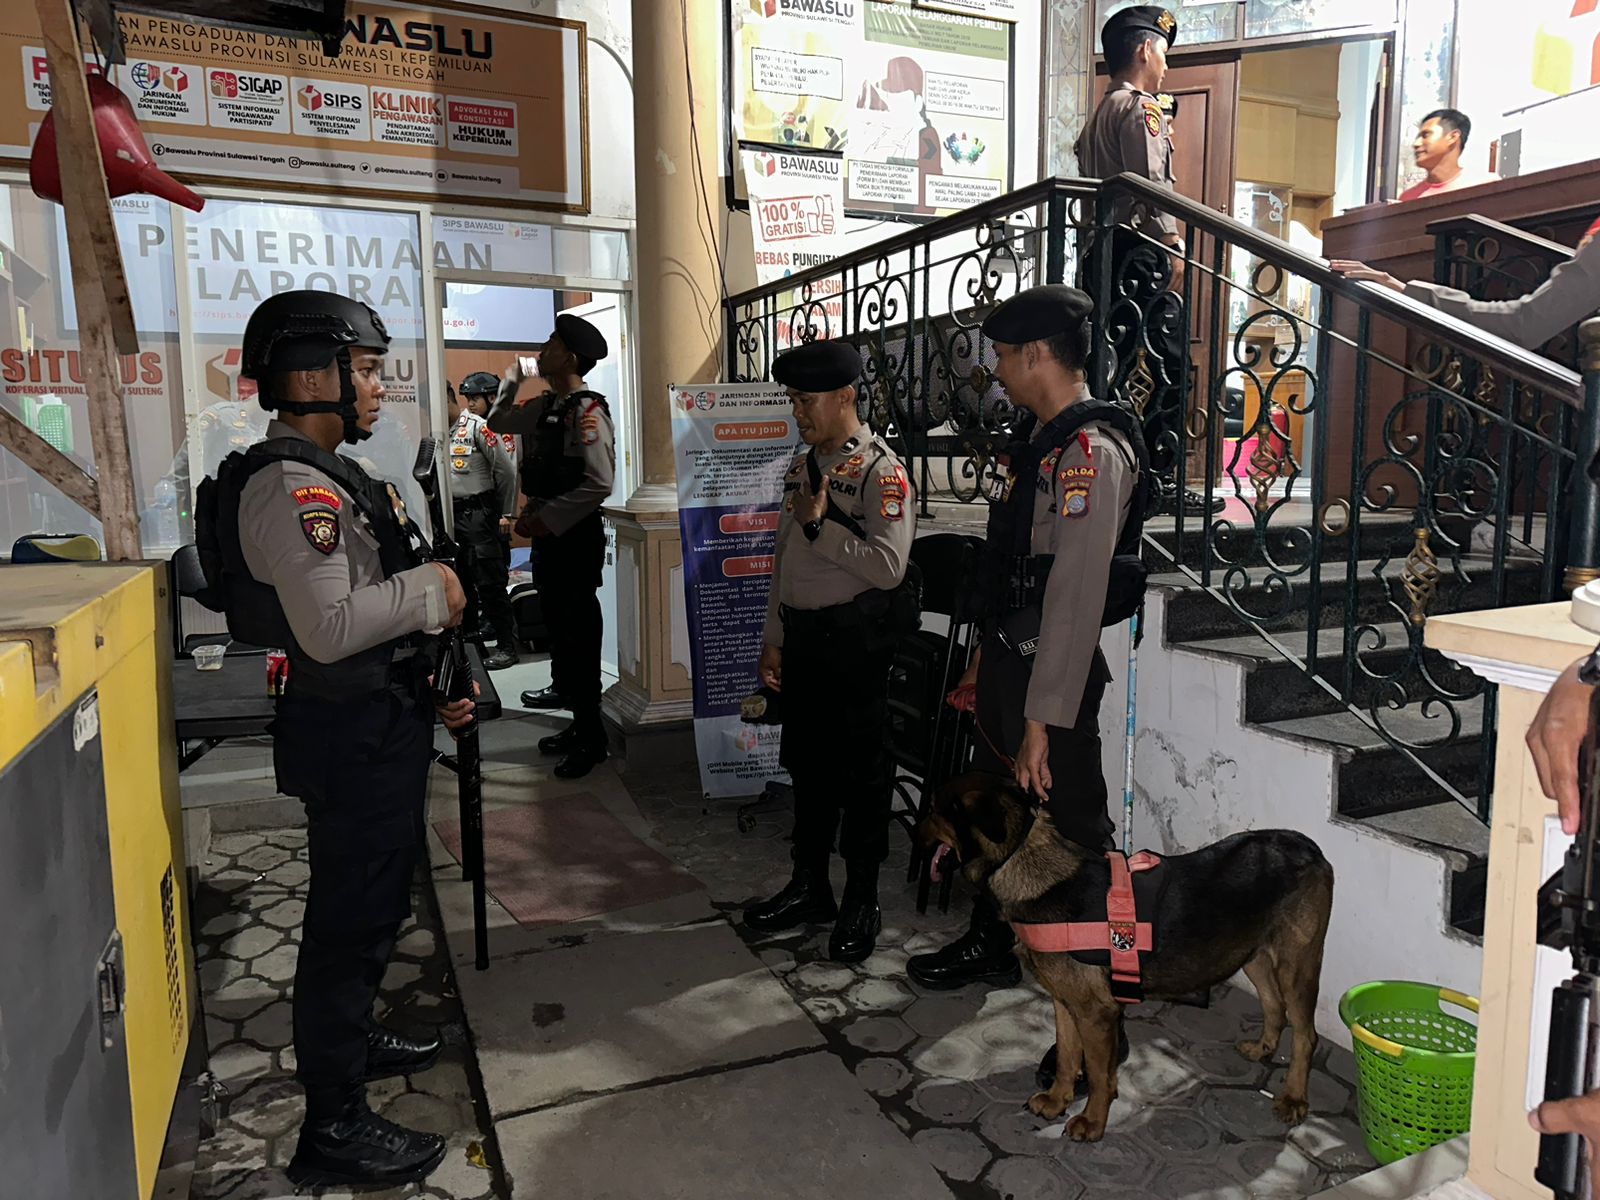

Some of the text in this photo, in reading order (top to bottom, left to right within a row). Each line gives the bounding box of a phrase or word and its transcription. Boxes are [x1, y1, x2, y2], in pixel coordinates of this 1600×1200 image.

[781, 11, 805, 19] PROVINSI
[871, 2, 1003, 31] LAPORAN PELANGGARAN PEMILU
[342, 14, 492, 60] WASLU
[149, 20, 257, 45] PENGADUAN
[265, 35, 298, 50] DAN
[400, 52, 492, 73] KEPEMILUAN
[211, 42, 290, 63] PROVINSI
[298, 53, 377, 73] SULAWESI
[384, 64, 445, 81] TENGAH
[33, 83, 50, 91] PEJA
[238, 76, 282, 94] SIGAP
[143, 90, 182, 100] JARINGAN
[139, 98, 187, 107] DOKUMENTASI
[323, 93, 362, 109] SIPS
[373, 91, 442, 116] KLINIK
[153, 104, 189, 113] INFORMASI
[243, 105, 280, 114] INFORMASI
[453, 105, 509, 118] ADVOKASI DAN
[227, 111, 274, 120] PENGAWASAN
[301, 112, 361, 124] SISTEM INFORMASI
[373, 110, 443, 126] PENGAWASAN
[458, 114, 505, 125] KONSULTASI
[229, 117, 273, 126] PARTISIPATIF
[309, 120, 356, 130] PENYELESAIAN
[316, 127, 349, 135] SENGKETA
[386, 122, 431, 132] PENDAFTARAN
[458, 125, 506, 139] HUKUM
[381, 135, 415, 143] PEMANTAU
[400, 130, 435, 139] AKREDITASI
[452, 134, 512, 146] KEPEMILUAN
[165, 147, 285, 164] Bawaslu Provinsi Sulawesi Tengah
[300, 159, 355, 171] bawaslu.sulteng
[780, 156, 839, 175] BAWASLU
[374, 166, 433, 178] @bawaslu.sulteng
[801, 172, 822, 180] SULAWESI
[452, 173, 501, 184] Bawaslu Sulteng
[112, 199, 149, 209] WASLU
[762, 201, 805, 222] 100 %
[442, 219, 504, 231] SIPS BAWASLU
[755, 252, 790, 265] BEBAS
[5, 386, 47, 394] KOPERASI
[49, 386, 83, 395] VIRTUAL
[128, 387, 163, 396] SULTENG
[740, 399, 787, 407] INFORMASI
[719, 426, 785, 436] APA ITU JDIH?
[1060, 467, 1095, 480] POLDA
[748, 518, 767, 526] VISI
[703, 536, 743, 545] Memberikan
[693, 544, 736, 552] kemanfaatan
[750, 561, 770, 569] MISI
[700, 587, 739, 595] Dokumentasi
